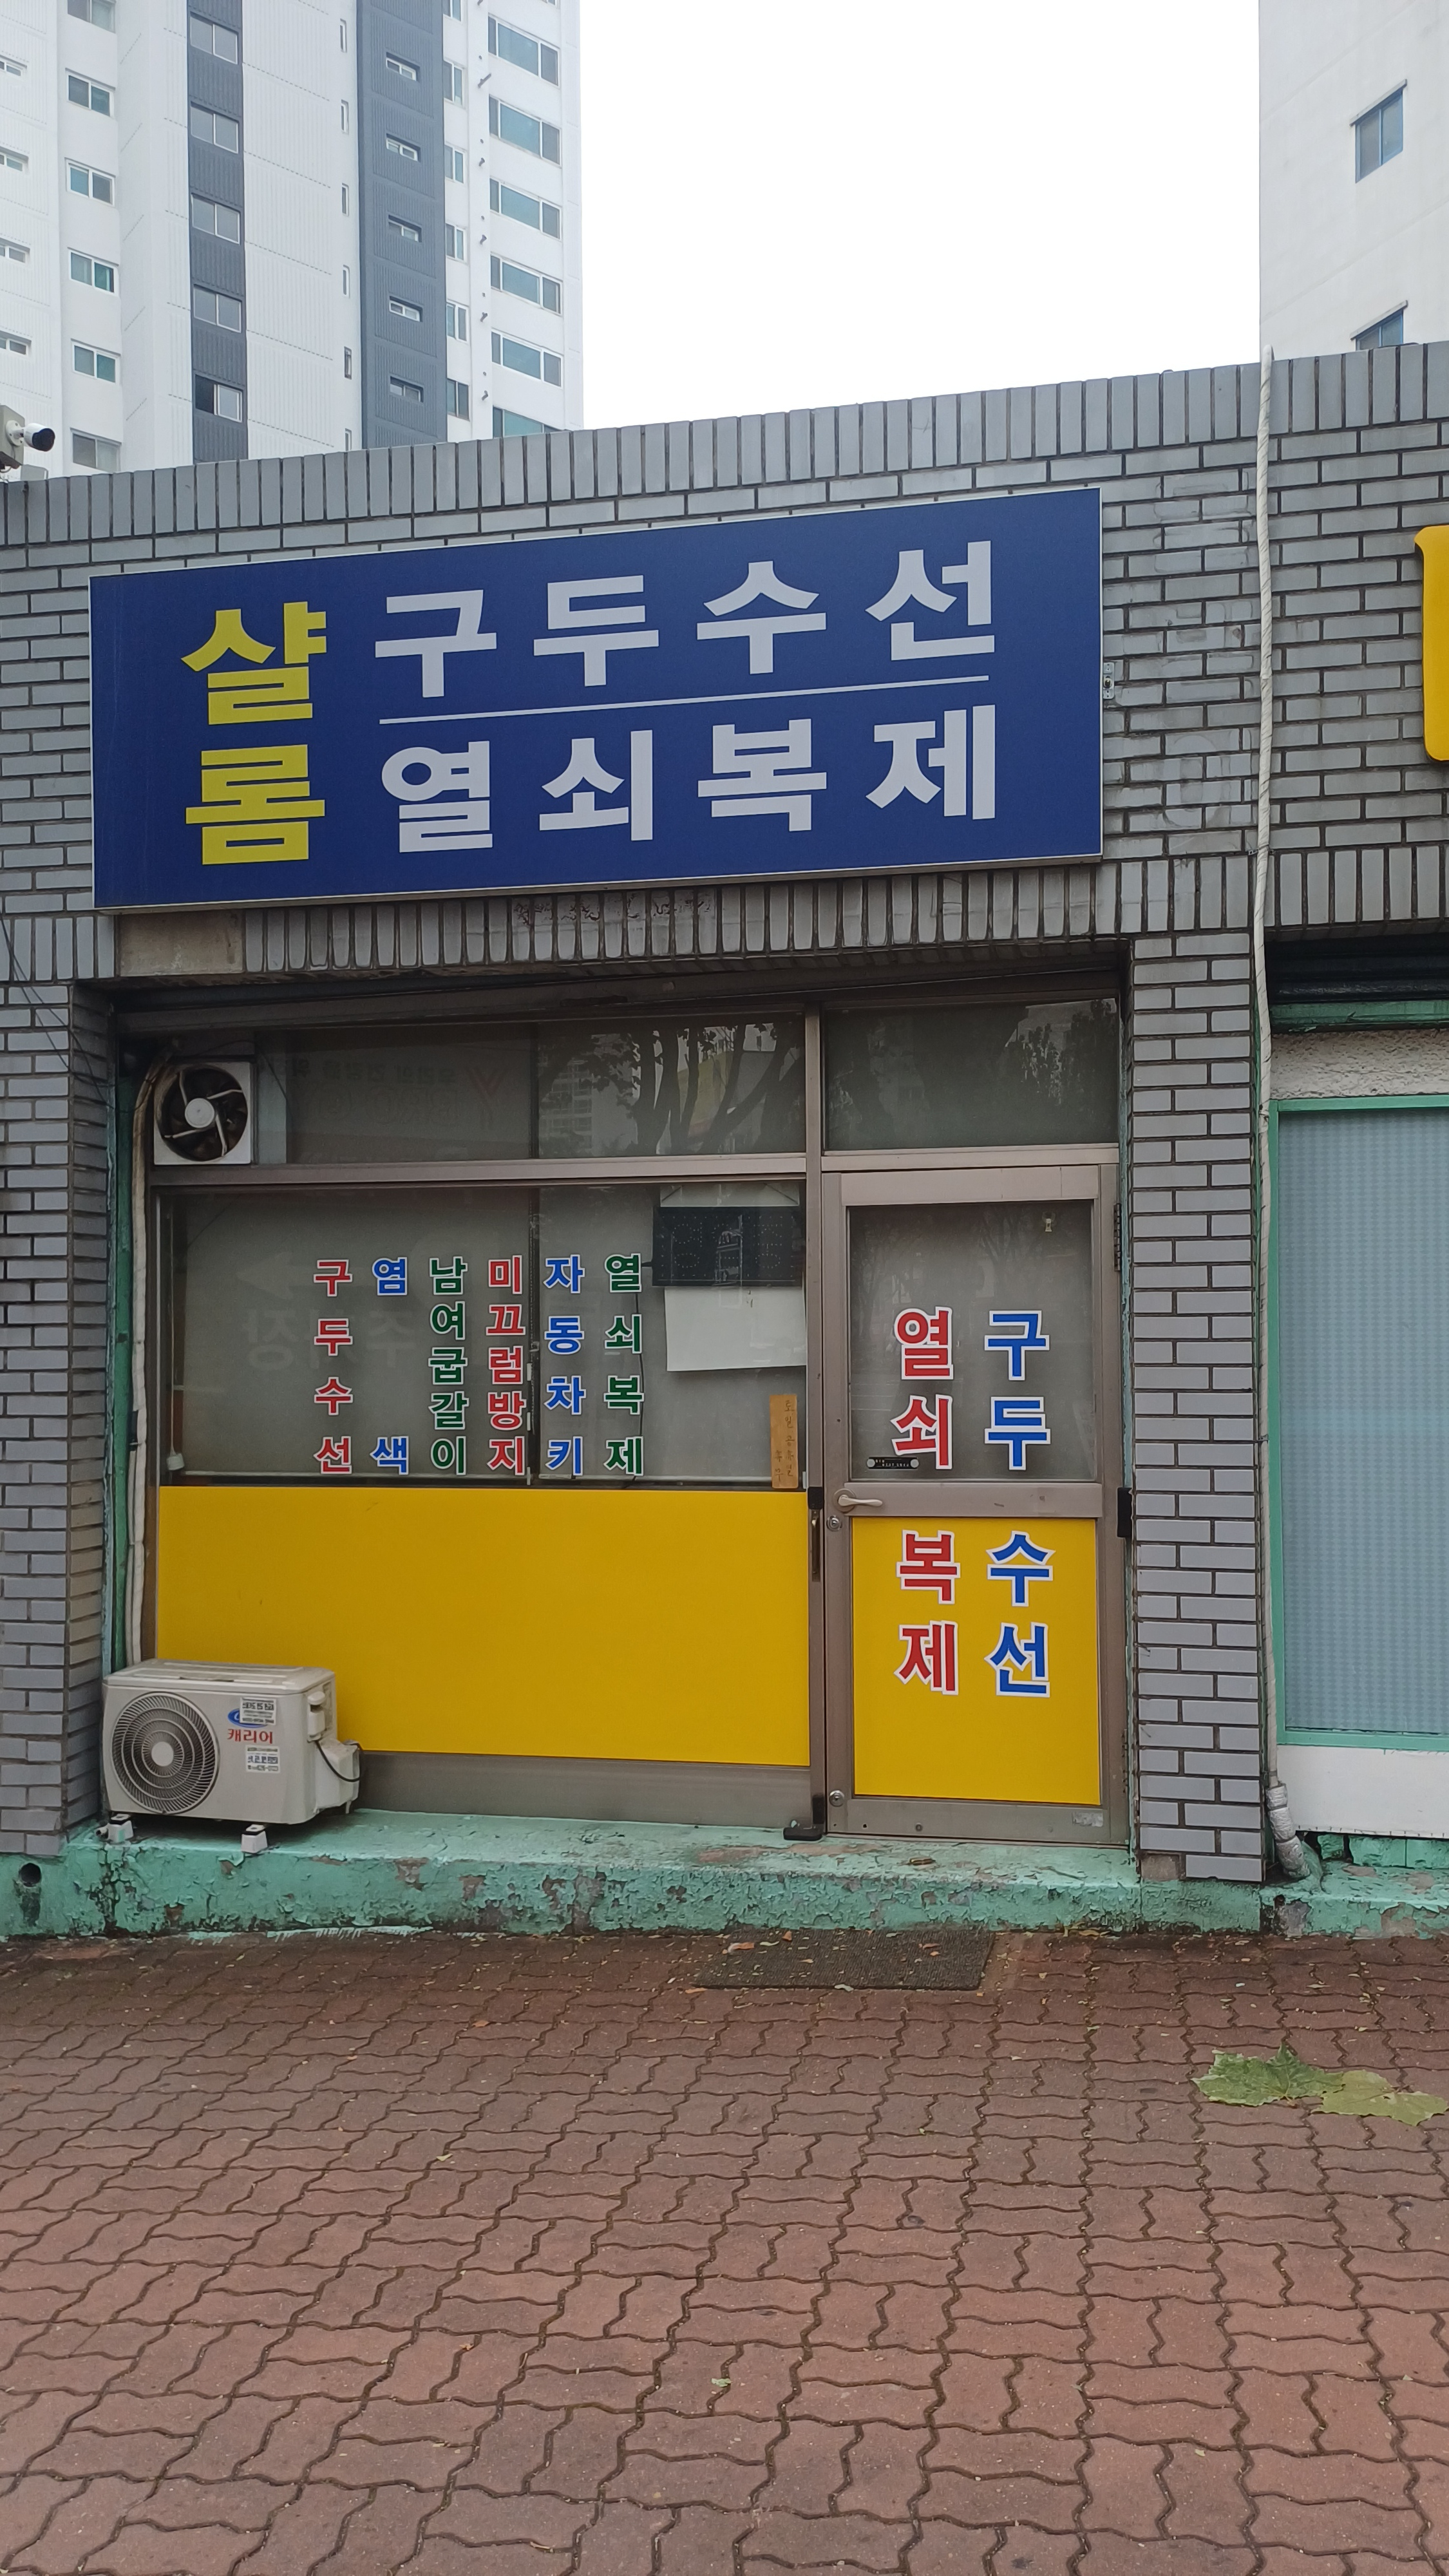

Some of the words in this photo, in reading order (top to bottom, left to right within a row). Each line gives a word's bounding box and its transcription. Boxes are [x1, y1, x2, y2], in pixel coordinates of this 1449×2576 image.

[374, 540, 996, 699] 구두수선
[182, 601, 327, 866] 샬롬
[379, 704, 996, 854] 열쇠복제
[314, 1259, 352, 1474] 구두수선
[428, 1256, 469, 1475] 남여굽갈이
[486, 1255, 526, 1475] 미끄럼방지
[544, 1255, 585, 1475] 자동차키
[603, 1253, 643, 1475] 열쇠복제
[891, 1307, 953, 1470] 열쇠
[984, 1311, 1050, 1470] 구두
[896, 1530, 960, 1695] 복제
[986, 1530, 1055, 1698] 수선
[227, 1728, 273, 1745] 캐리어
